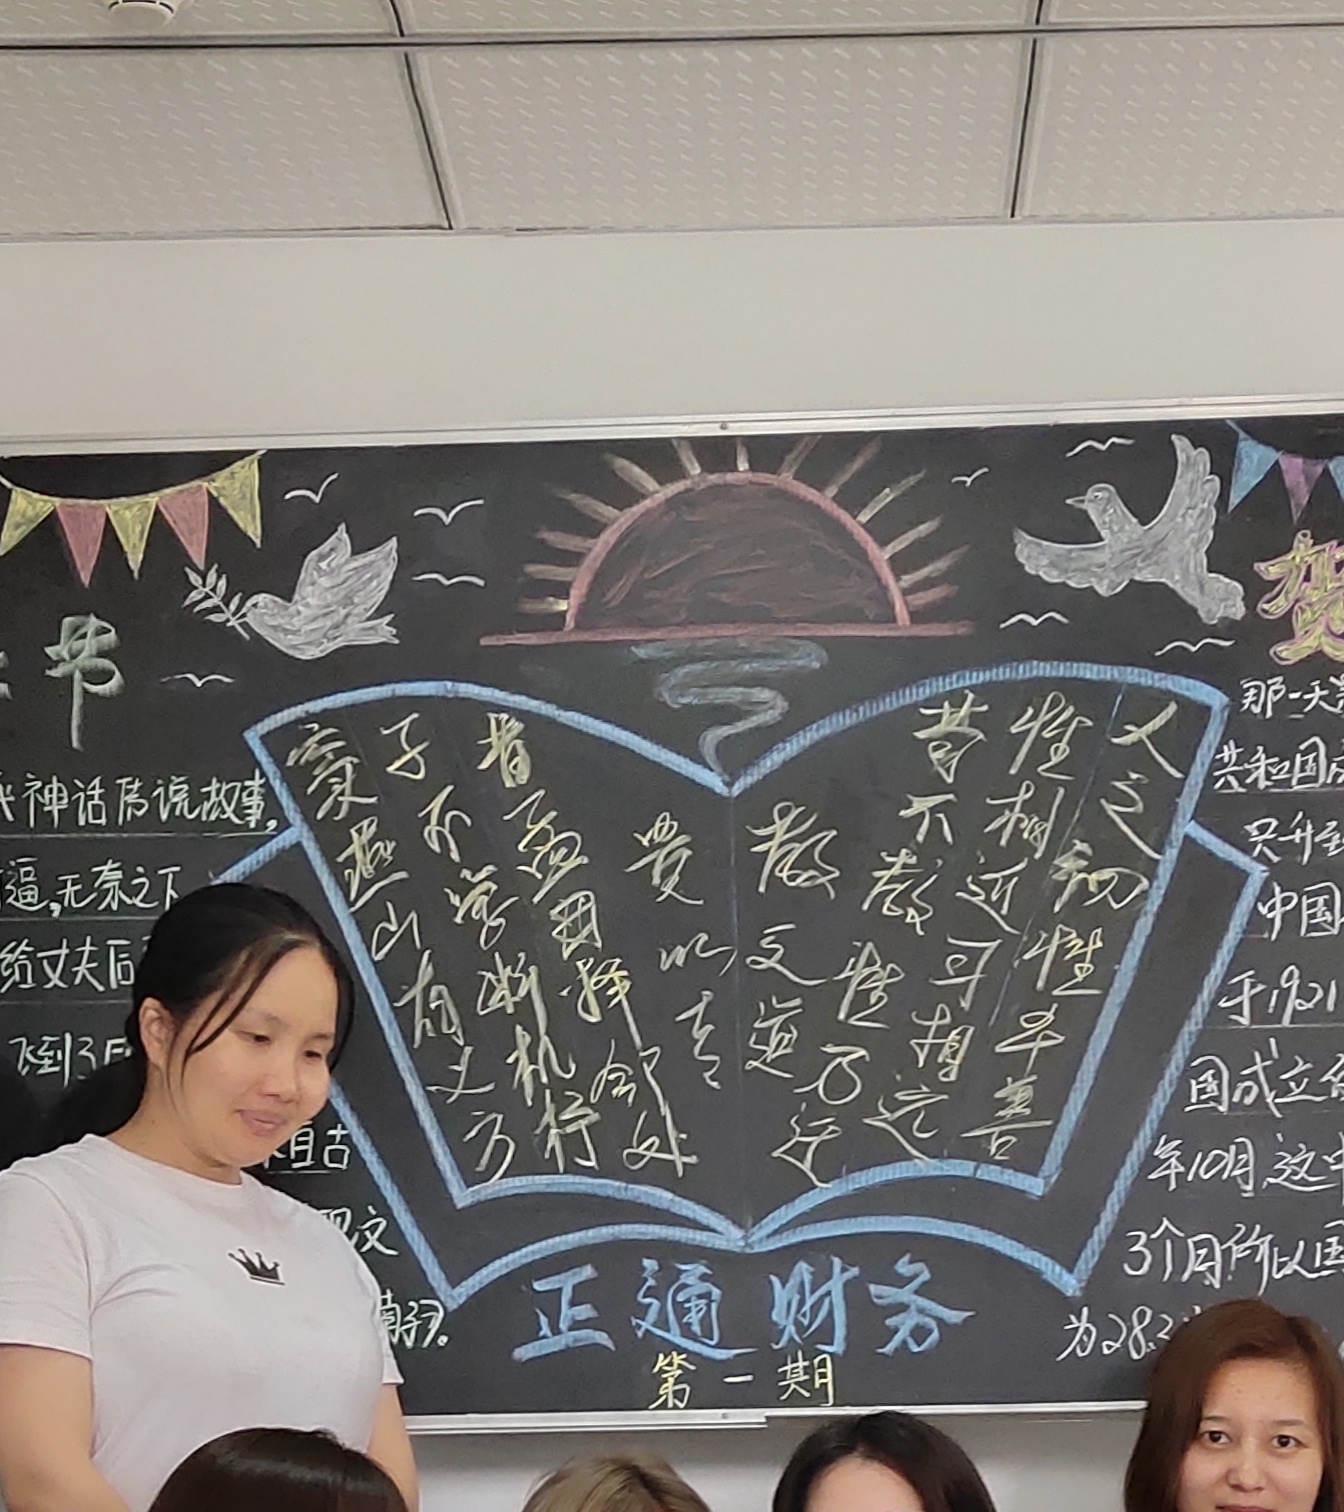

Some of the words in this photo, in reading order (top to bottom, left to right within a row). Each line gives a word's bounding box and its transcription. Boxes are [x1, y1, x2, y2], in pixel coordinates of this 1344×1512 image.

[511, 1253, 977, 1362] 正通财务
[648, 1350, 835, 1411] 第一期
